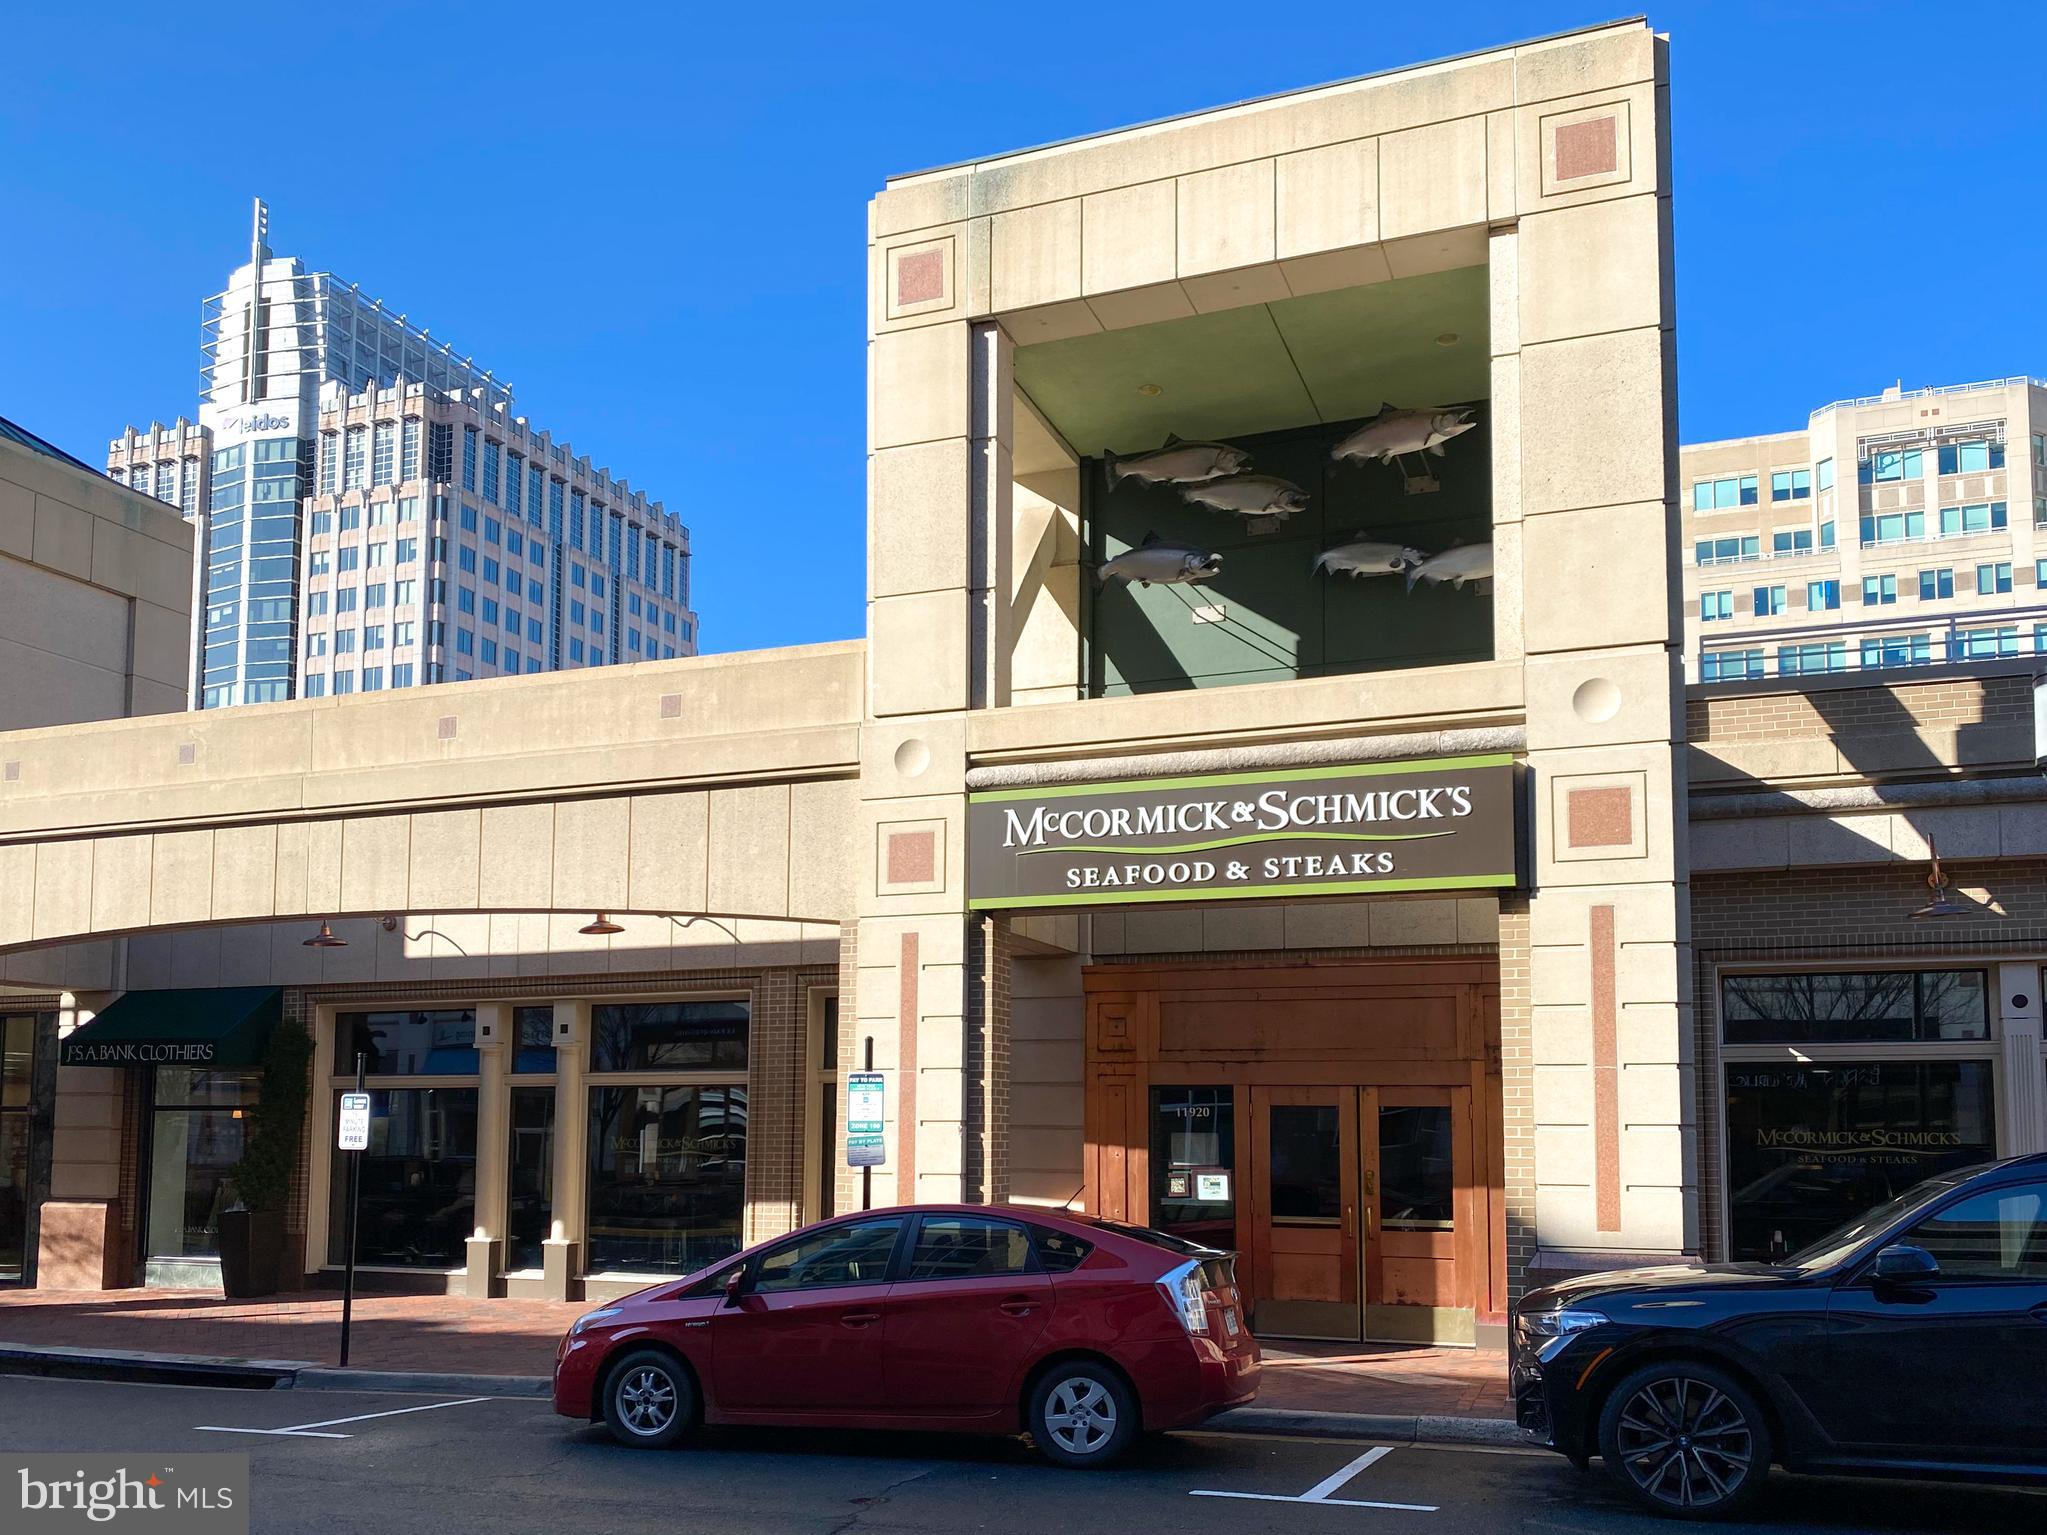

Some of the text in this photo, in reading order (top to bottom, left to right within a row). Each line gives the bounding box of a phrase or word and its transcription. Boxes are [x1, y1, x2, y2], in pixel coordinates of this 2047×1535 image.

[241, 413, 290, 434] leidos
[1257, 786, 1473, 831] SCHMICK'S
[1066, 852, 1396, 889] SEAFOOD & STEAKS
[100, 1044, 137, 1061] BANK
[139, 1044, 214, 1061] CLOTHIERS
[1177, 1107, 1210, 1118] 11920
[344, 1135, 364, 1143] FREE
[1871, 1129, 1961, 1146] SCHMICK'S
[1798, 1155, 1857, 1165] SEAFOOD
[1870, 1154, 1918, 1165] STEAKS
